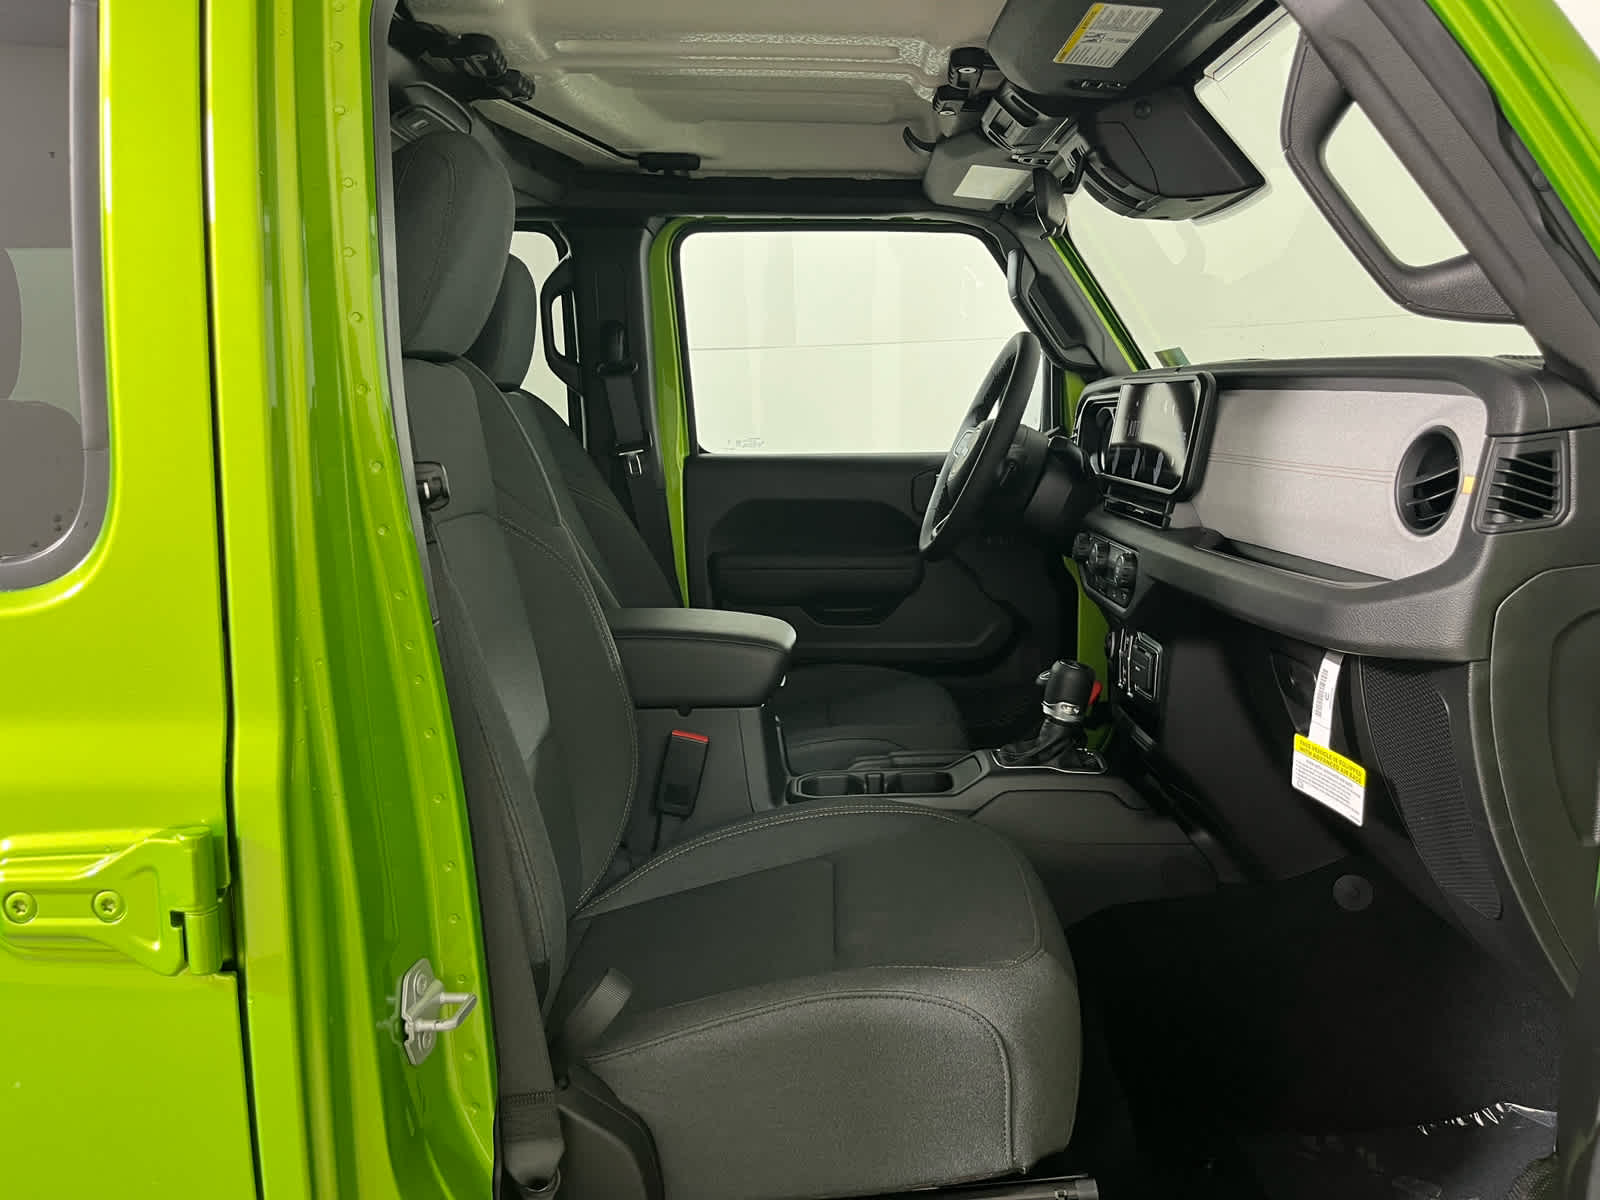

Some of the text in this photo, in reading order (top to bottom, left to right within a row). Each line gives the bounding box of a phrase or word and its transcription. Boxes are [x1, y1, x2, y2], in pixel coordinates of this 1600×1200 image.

[1299, 747, 1361, 784] WITH ADVANCED AIR BAGS
[1312, 746, 1332, 760] VEHICLE
[1339, 760, 1362, 776] EQUIPPED
